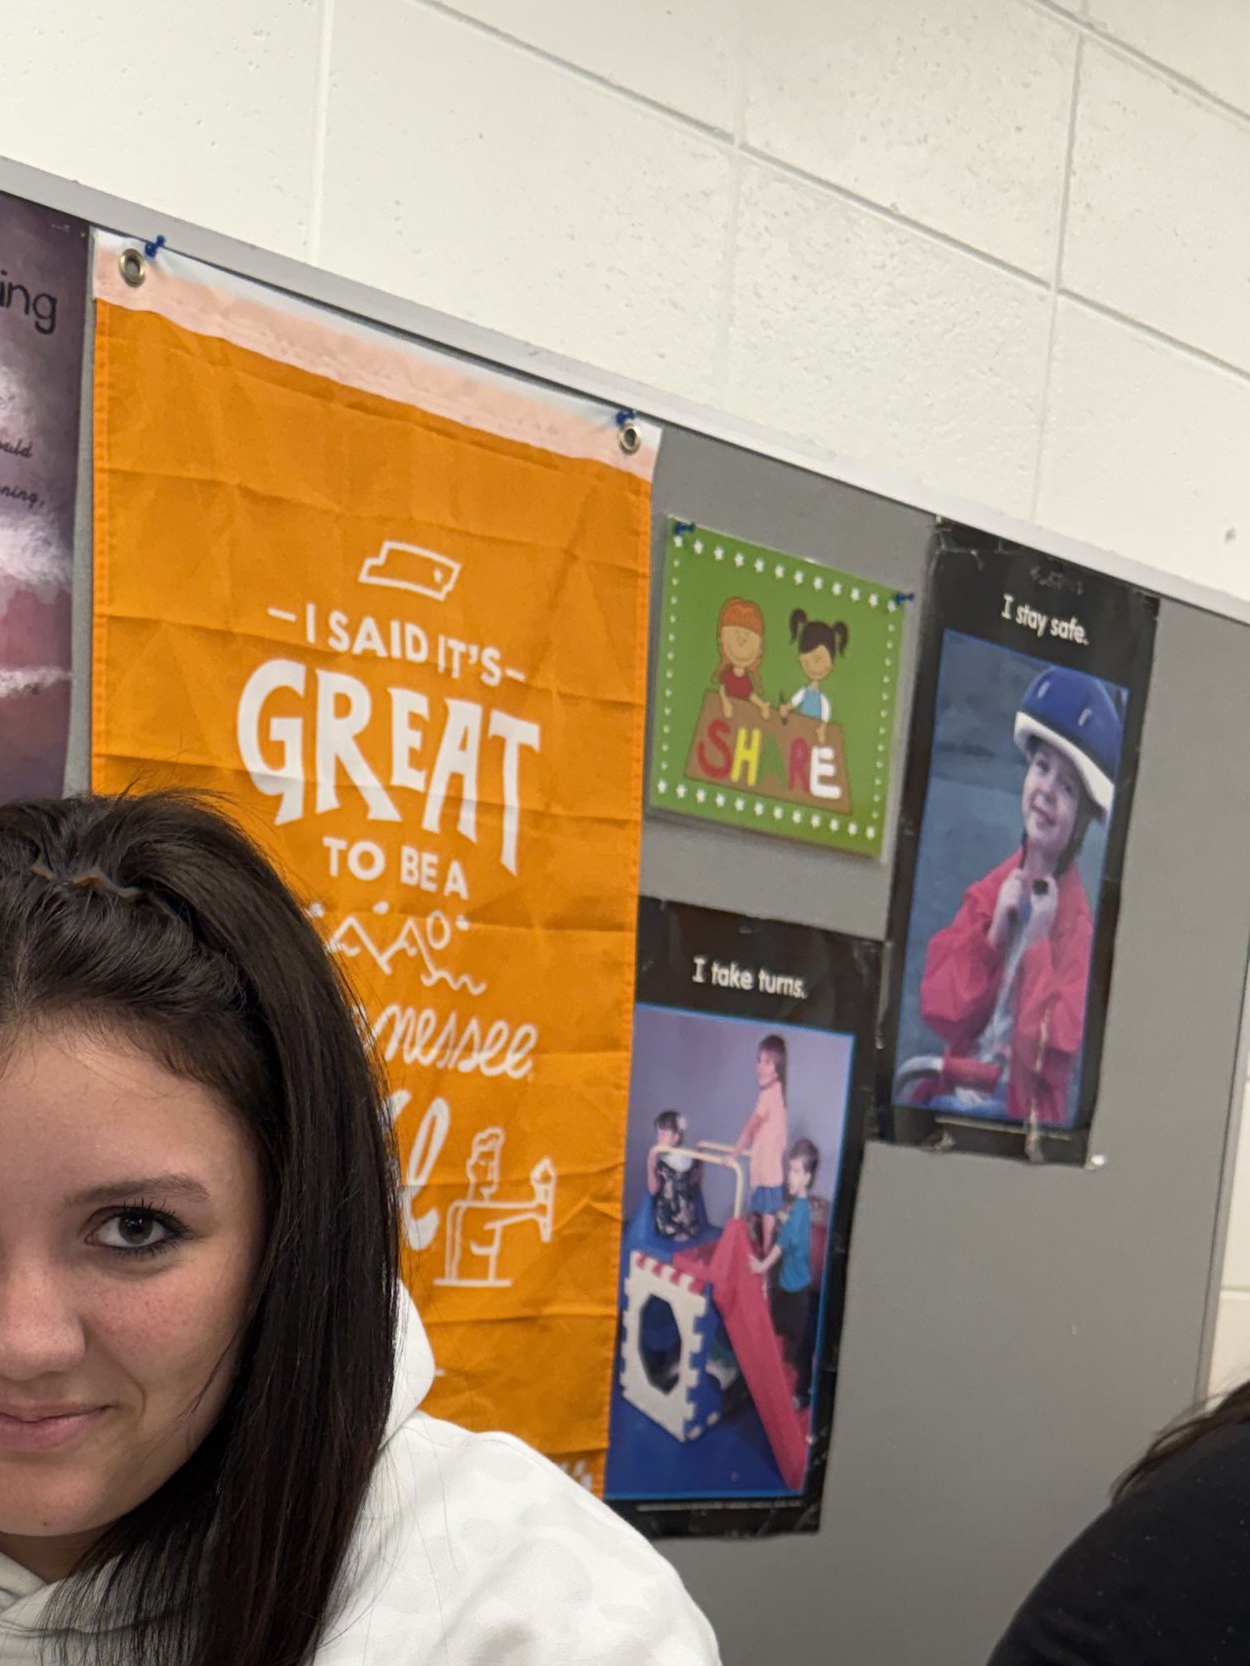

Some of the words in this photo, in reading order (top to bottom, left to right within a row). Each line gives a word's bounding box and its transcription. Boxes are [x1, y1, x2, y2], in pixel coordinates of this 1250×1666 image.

[306, 603, 316, 644] I
[328, 610, 429, 663] SAID
[438, 634, 503, 687] IT'S
[1002, 593, 1015, 620] I
[1016, 604, 1048, 638] stay
[1050, 616, 1089, 646] safe.
[236, 658, 541, 877] GREAT
[697, 719, 842, 799] SHARE
[322, 836, 386, 881] TO
[400, 845, 438, 892] BE
[444, 859, 469, 900] A
[692, 957, 706, 983] I
[711, 961, 754, 991] take
[758, 968, 807, 999] turns.
